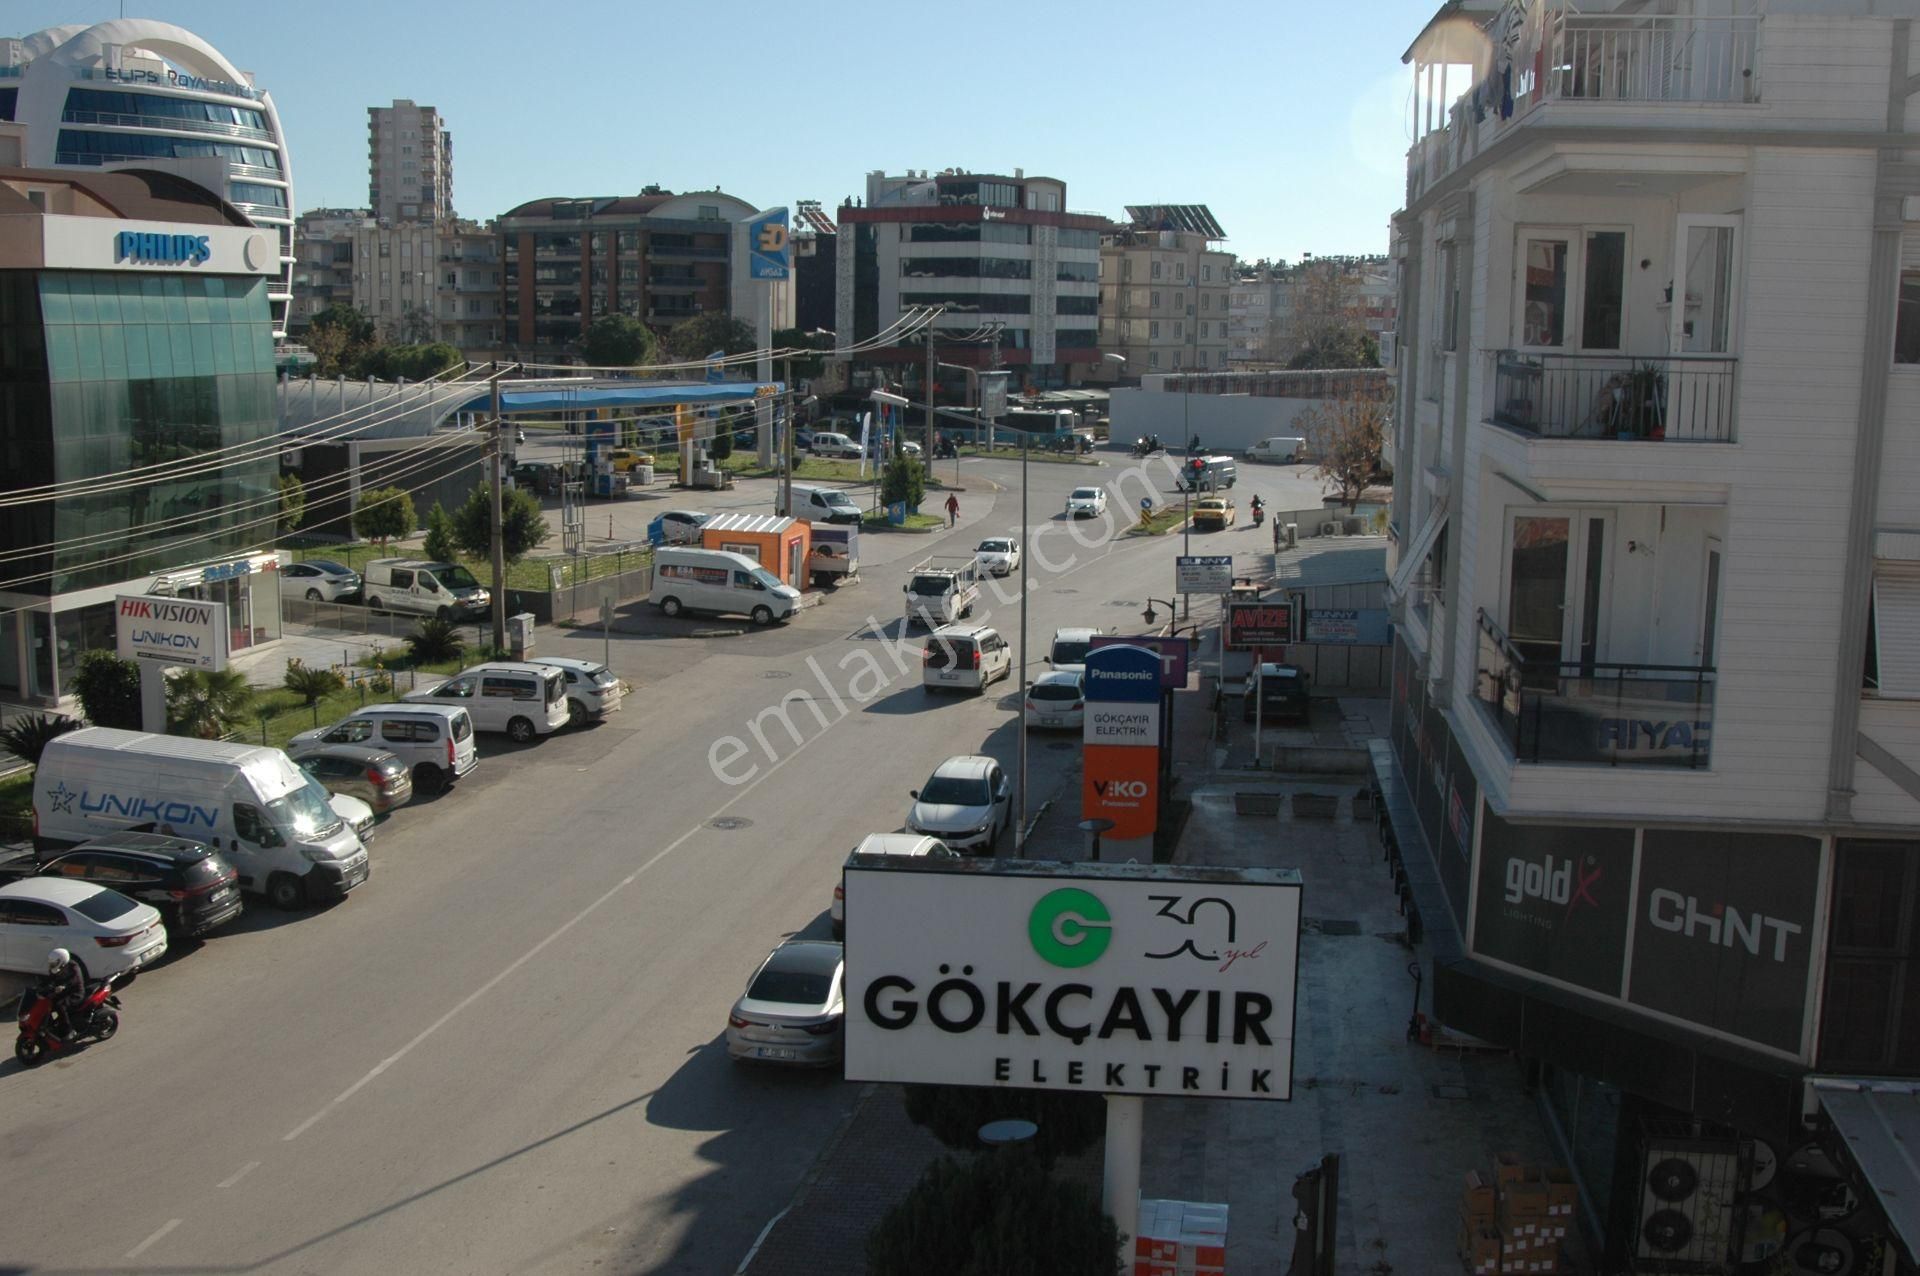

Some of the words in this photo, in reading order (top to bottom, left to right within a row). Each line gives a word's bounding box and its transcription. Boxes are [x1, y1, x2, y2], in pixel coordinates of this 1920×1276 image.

[116, 231, 210, 264] PHILIPS
[120, 600, 211, 625] HIKVISION
[132, 630, 199, 649] UNIKON
[1091, 668, 1153, 681] Panasonic
[1094, 711, 1150, 724] GÖKÇAYIR
[79, 790, 218, 828] UNIKON
[863, 963, 1274, 1046] GÖKÇAYIR
[994, 1057, 1272, 1094] ELEKTRİK
